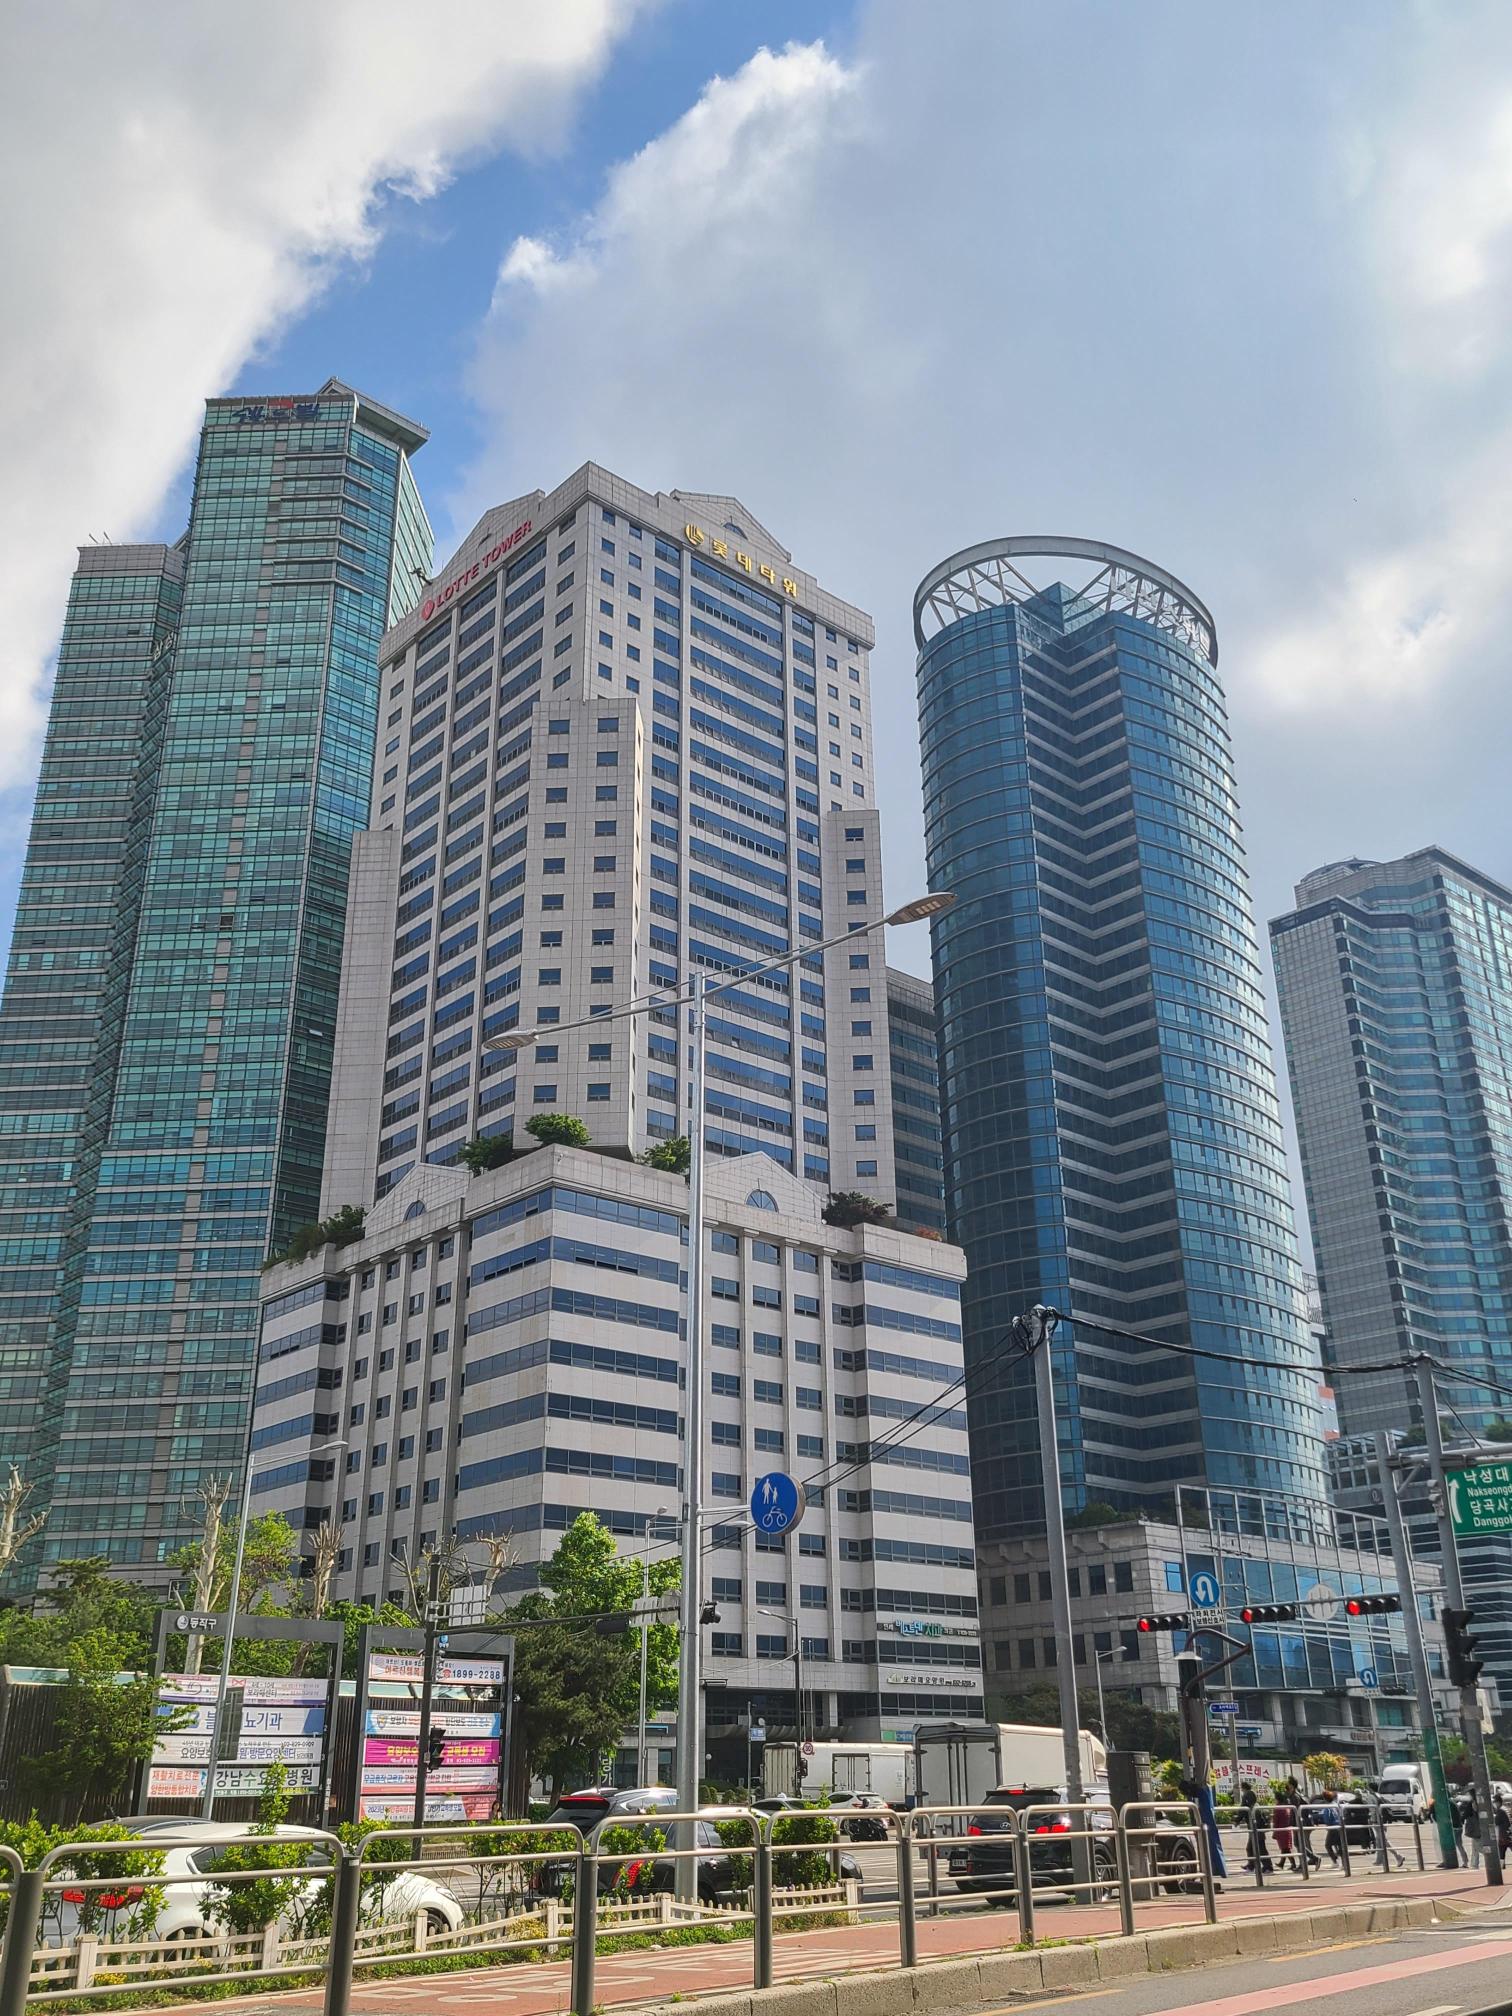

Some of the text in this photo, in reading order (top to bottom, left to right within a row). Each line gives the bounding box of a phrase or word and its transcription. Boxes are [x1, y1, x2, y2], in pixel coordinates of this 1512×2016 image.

[435, 520, 532, 608] LOTTE TOWER
[713, 538, 798, 598] 롯데타워
[1463, 1466, 1509, 1485] 낙성대
[216, 1769, 313, 1788] 강남수요병원
